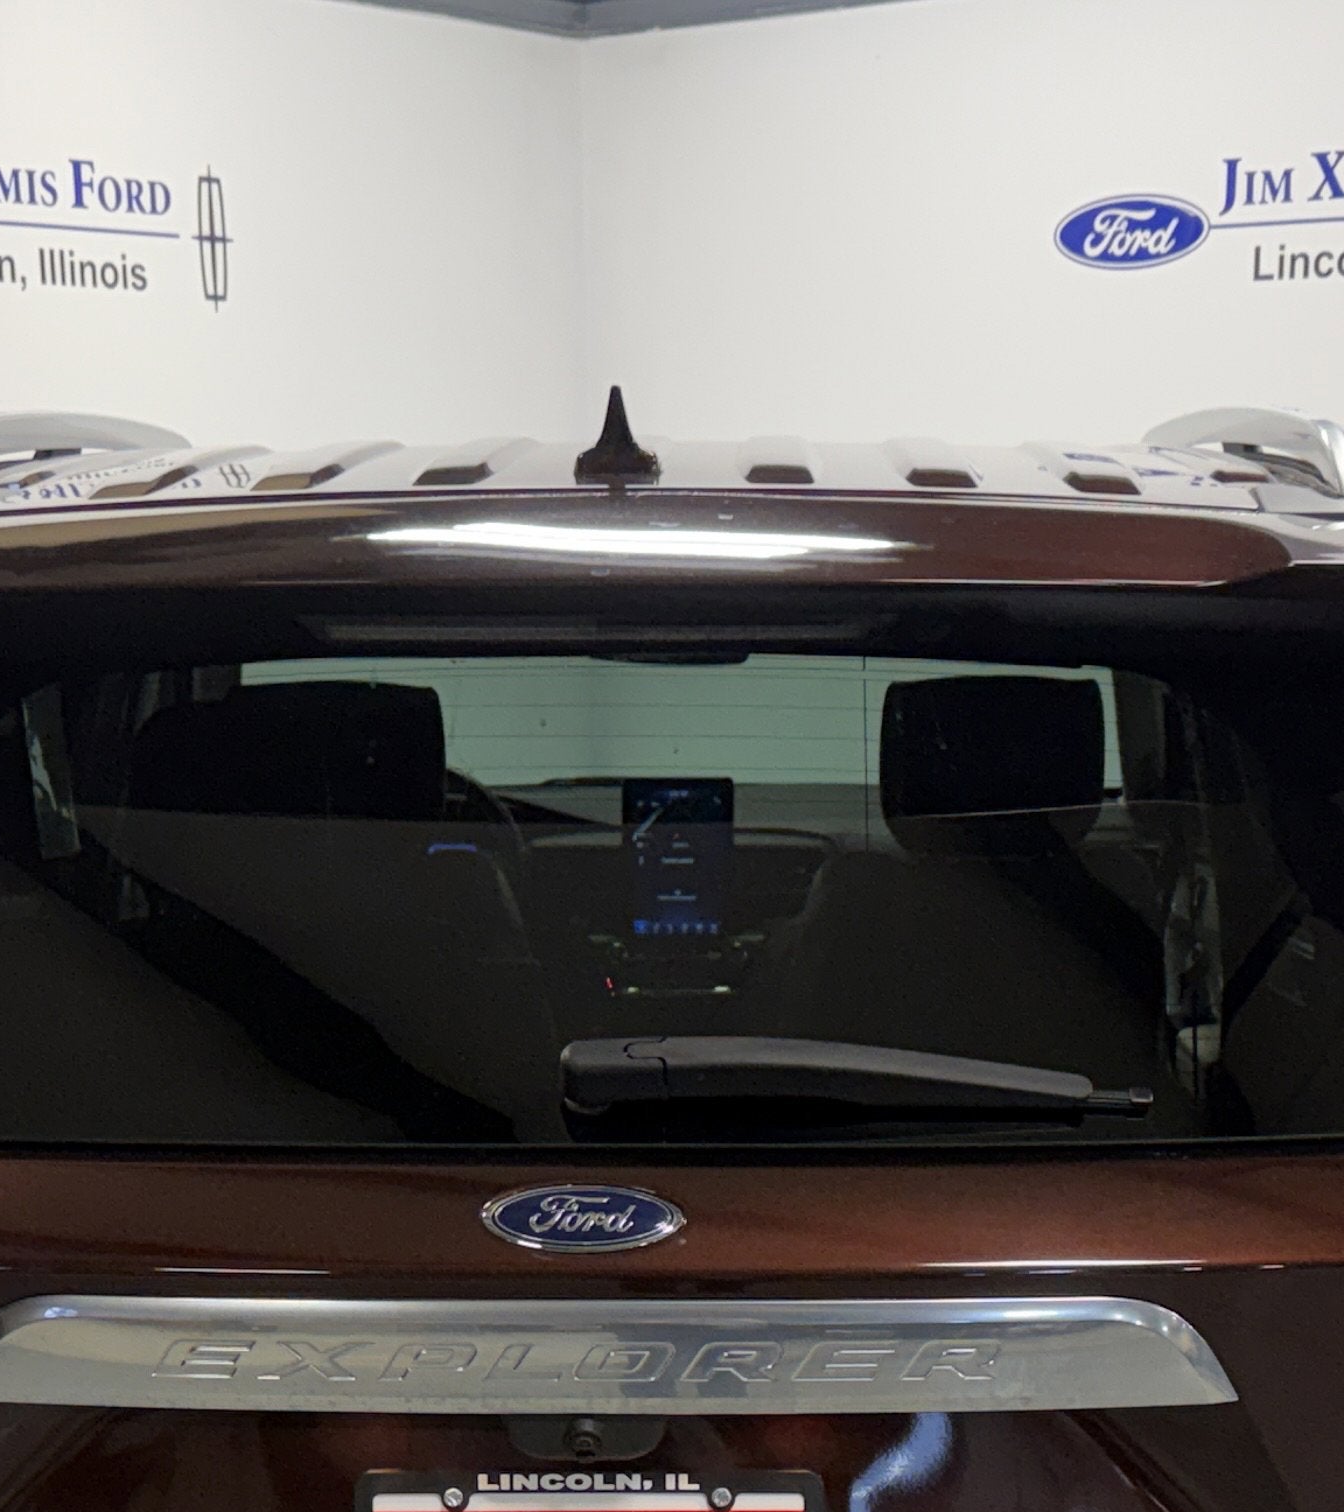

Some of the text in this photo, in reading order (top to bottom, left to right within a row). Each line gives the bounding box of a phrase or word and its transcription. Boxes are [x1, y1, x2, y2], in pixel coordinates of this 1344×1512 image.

[68, 159, 171, 216] FORD
[1220, 157, 1294, 216] JIM
[1082, 208, 1176, 258] Ford
[39, 248, 148, 291] Illinois
[526, 1194, 639, 1234] Ford
[154, 1338, 1010, 1383] EXPLORER
[477, 1473, 700, 1491] LINCOLN, IL
